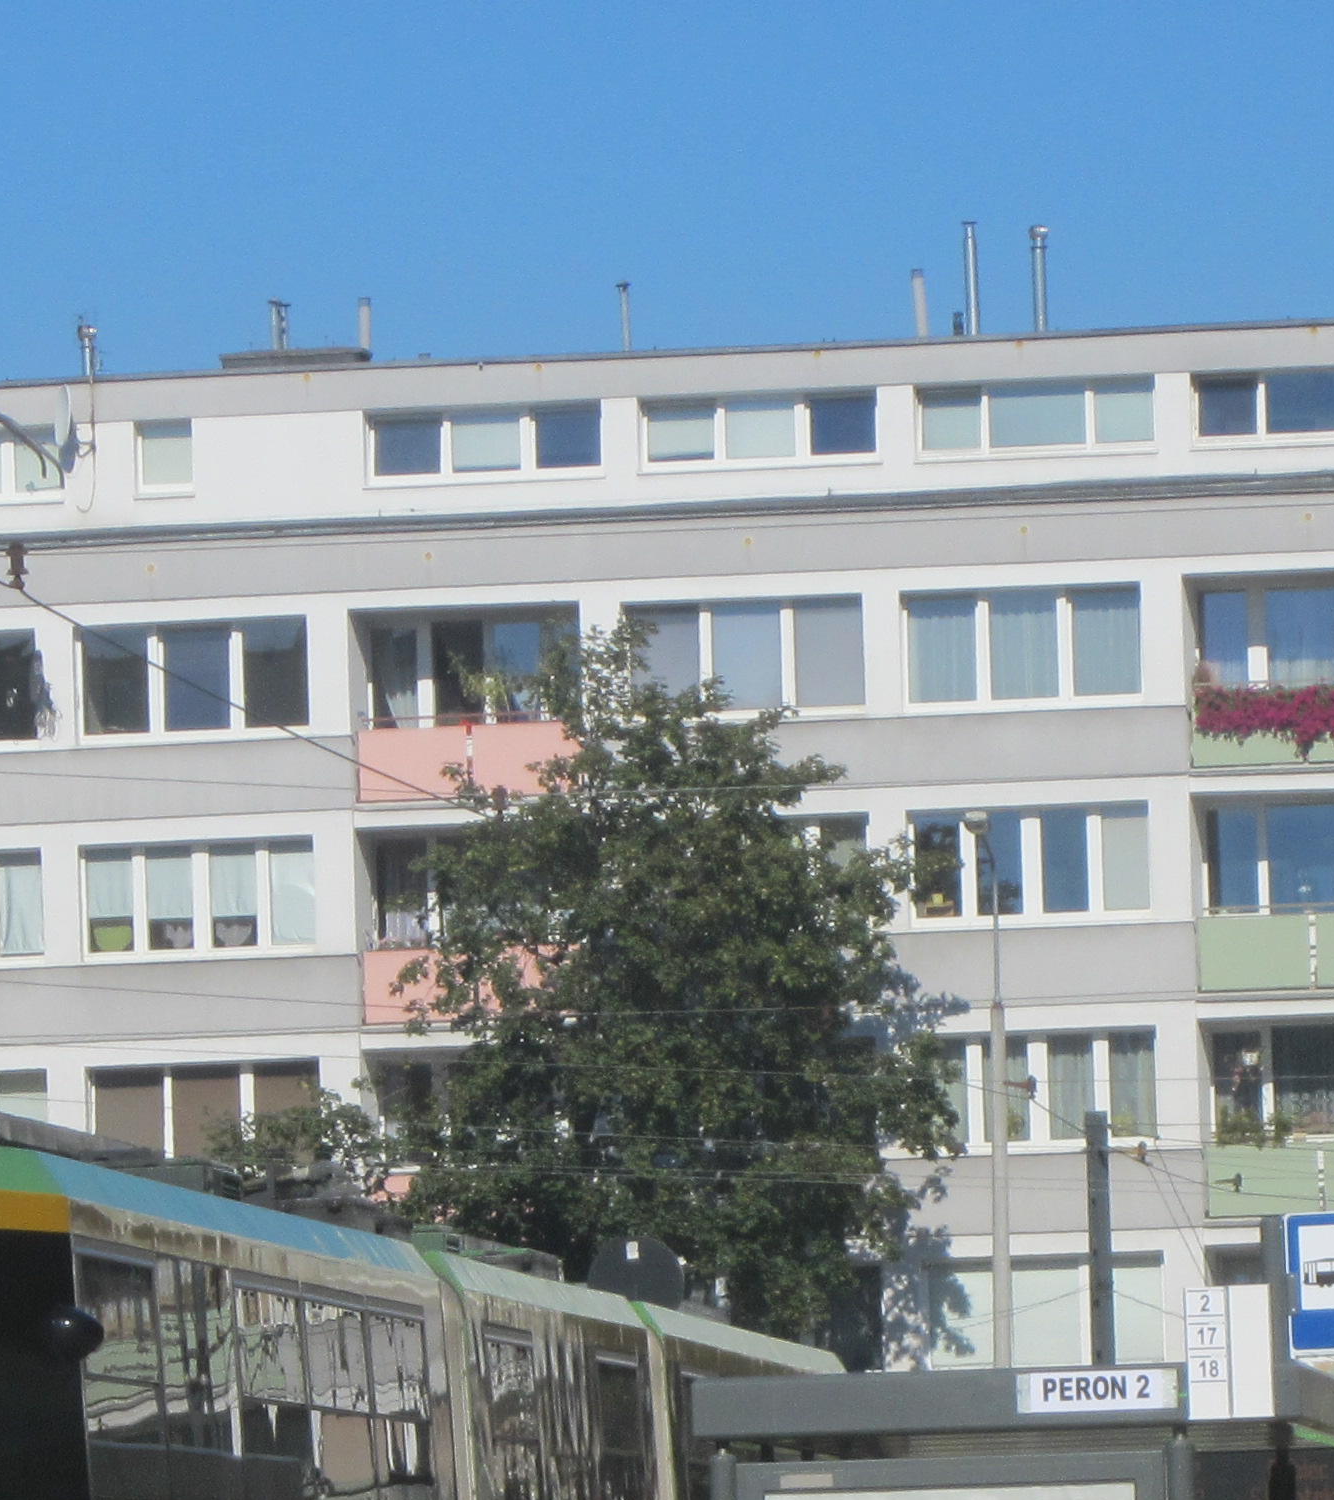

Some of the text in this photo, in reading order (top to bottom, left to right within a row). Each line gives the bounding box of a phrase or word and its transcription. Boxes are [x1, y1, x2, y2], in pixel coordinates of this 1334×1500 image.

[1199, 1294, 1211, 1313] 2
[1197, 1326, 1218, 1346] 17
[1199, 1359, 1220, 1379] 18
[1042, 1374, 1151, 1401] PERON 2
